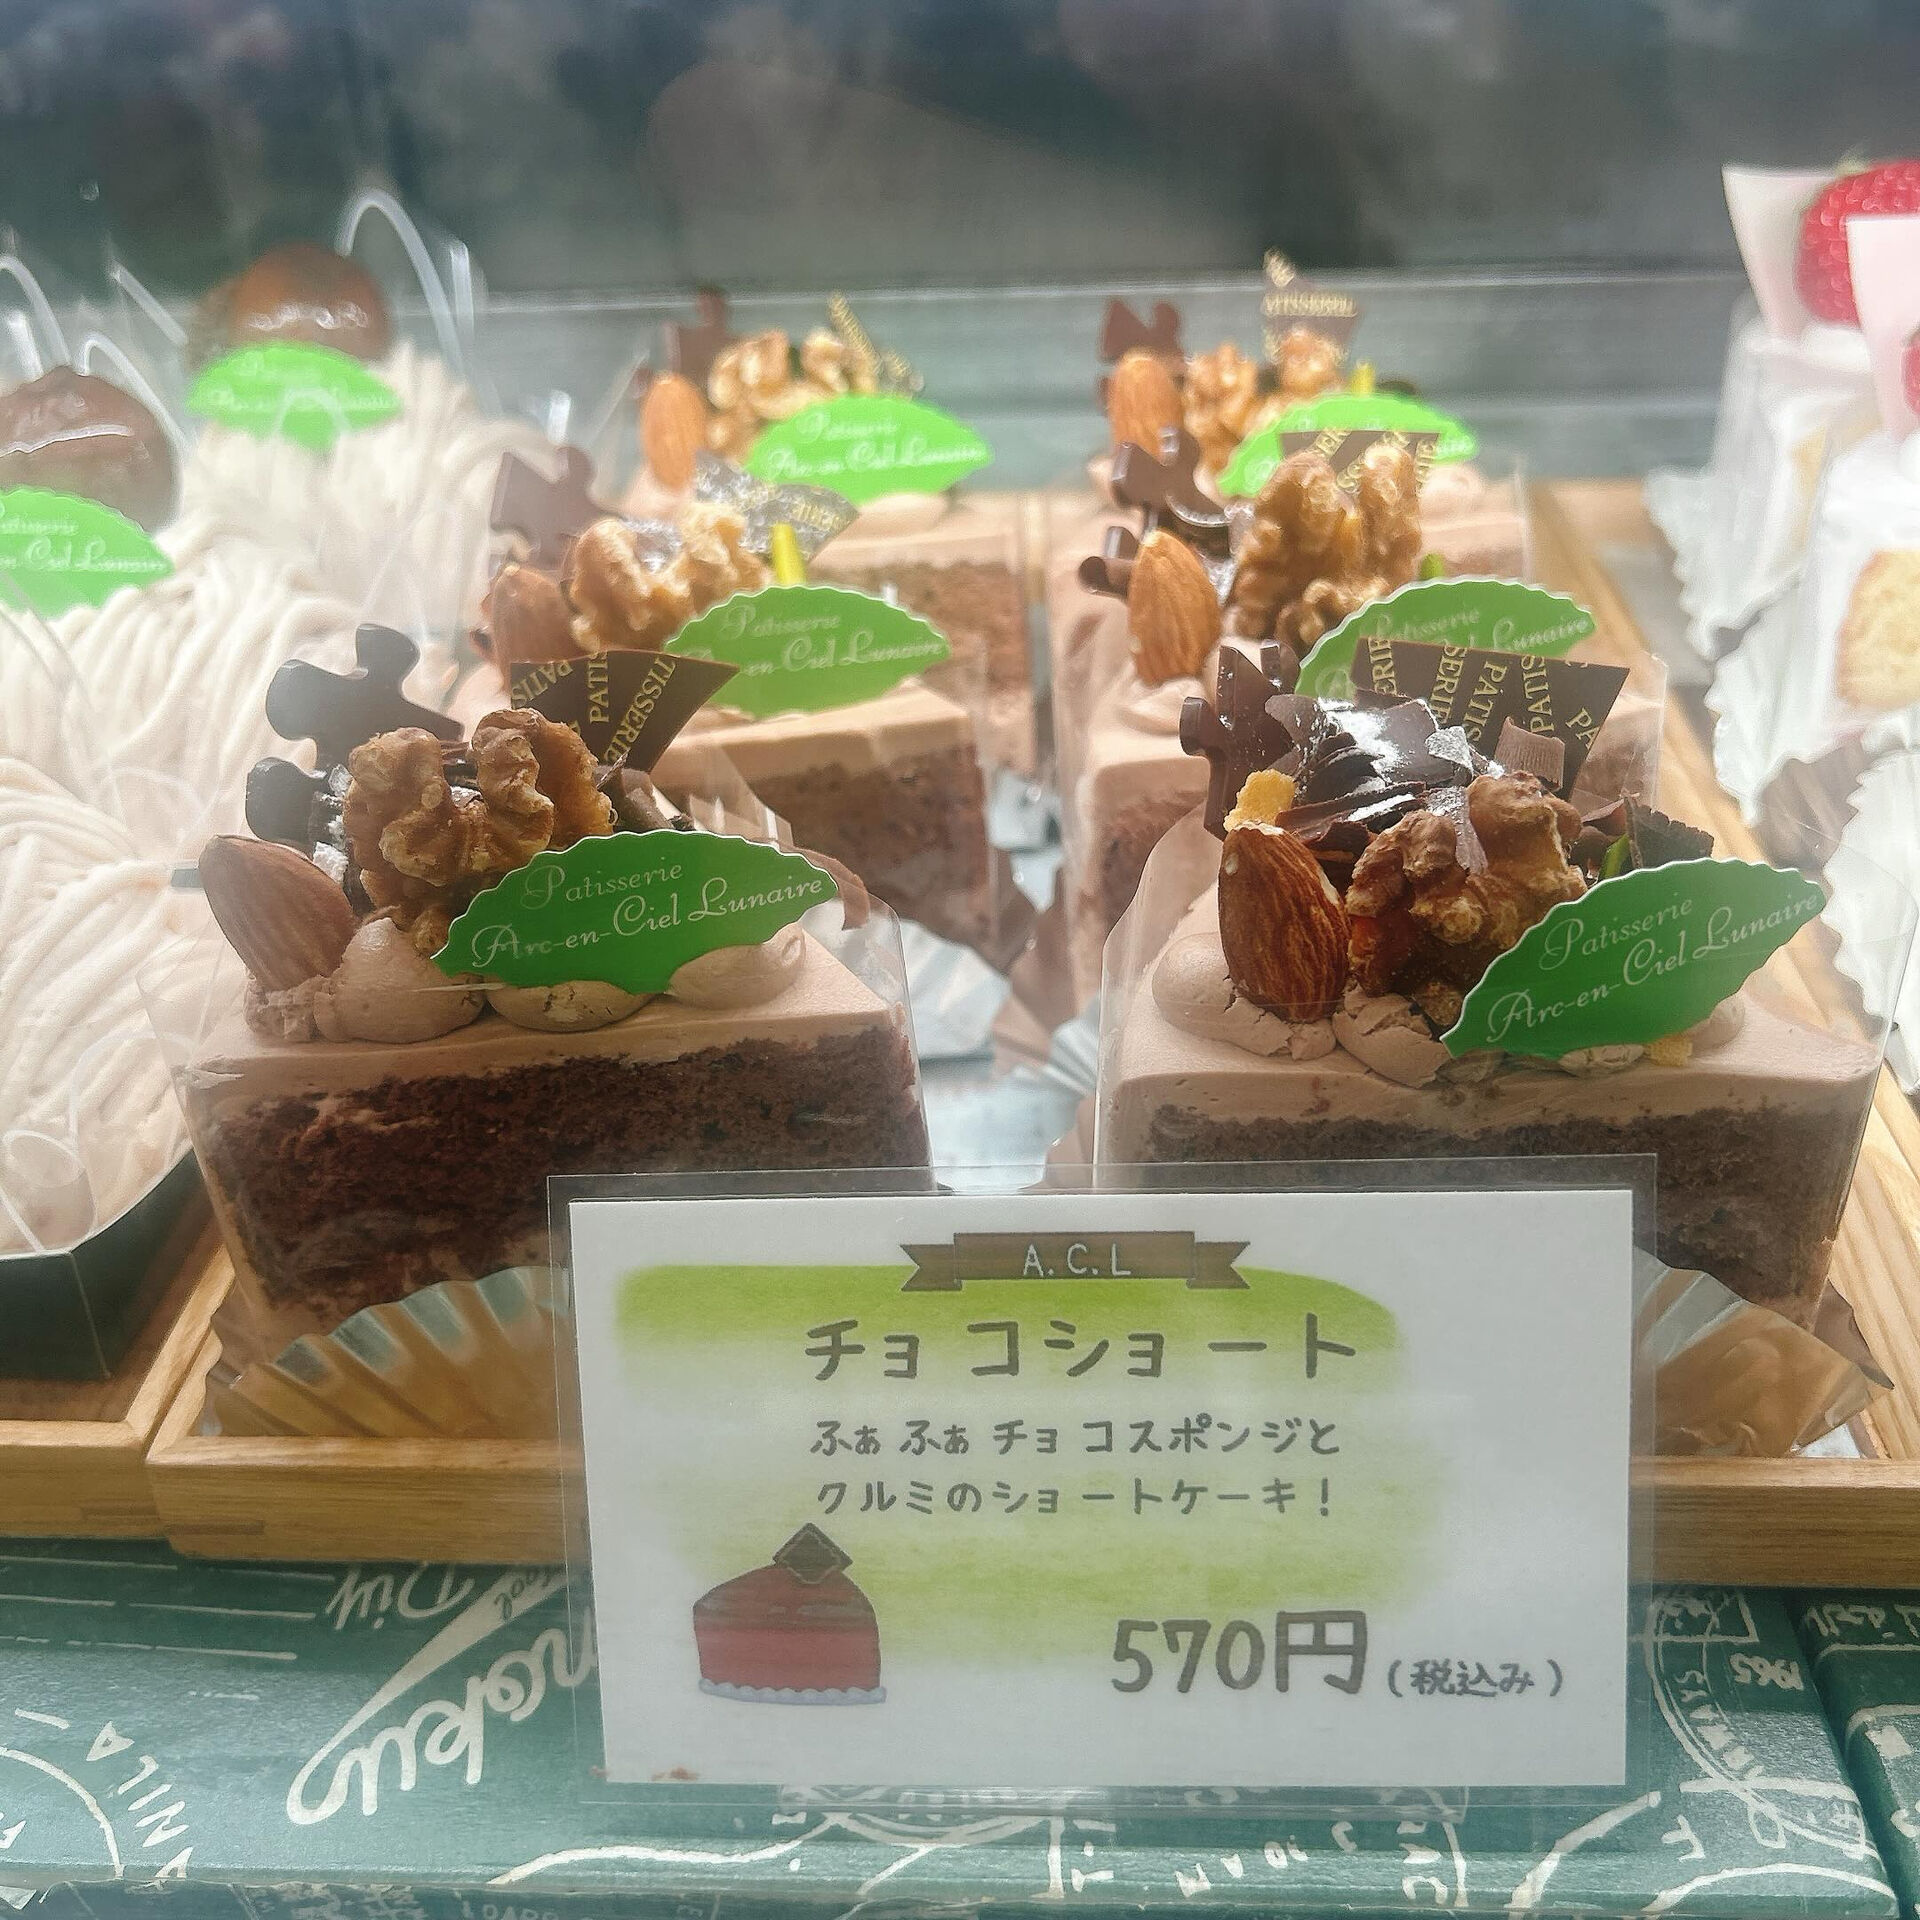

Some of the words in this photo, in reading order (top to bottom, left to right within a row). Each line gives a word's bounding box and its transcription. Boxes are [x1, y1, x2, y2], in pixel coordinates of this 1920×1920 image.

[471, 894, 681, 969] Arc-en-Ciel
[687, 873, 823, 923] Lunaire
[520, 856, 684, 911] Patisserie
[1485, 930, 1687, 1043] Arc-en-Ciel
[1692, 893, 1820, 960] Lunaire
[1538, 891, 1694, 972] Patisserie
[804, 1312, 1357, 1381] チョコショート
[1111, 1610, 1369, 1695] 570円
